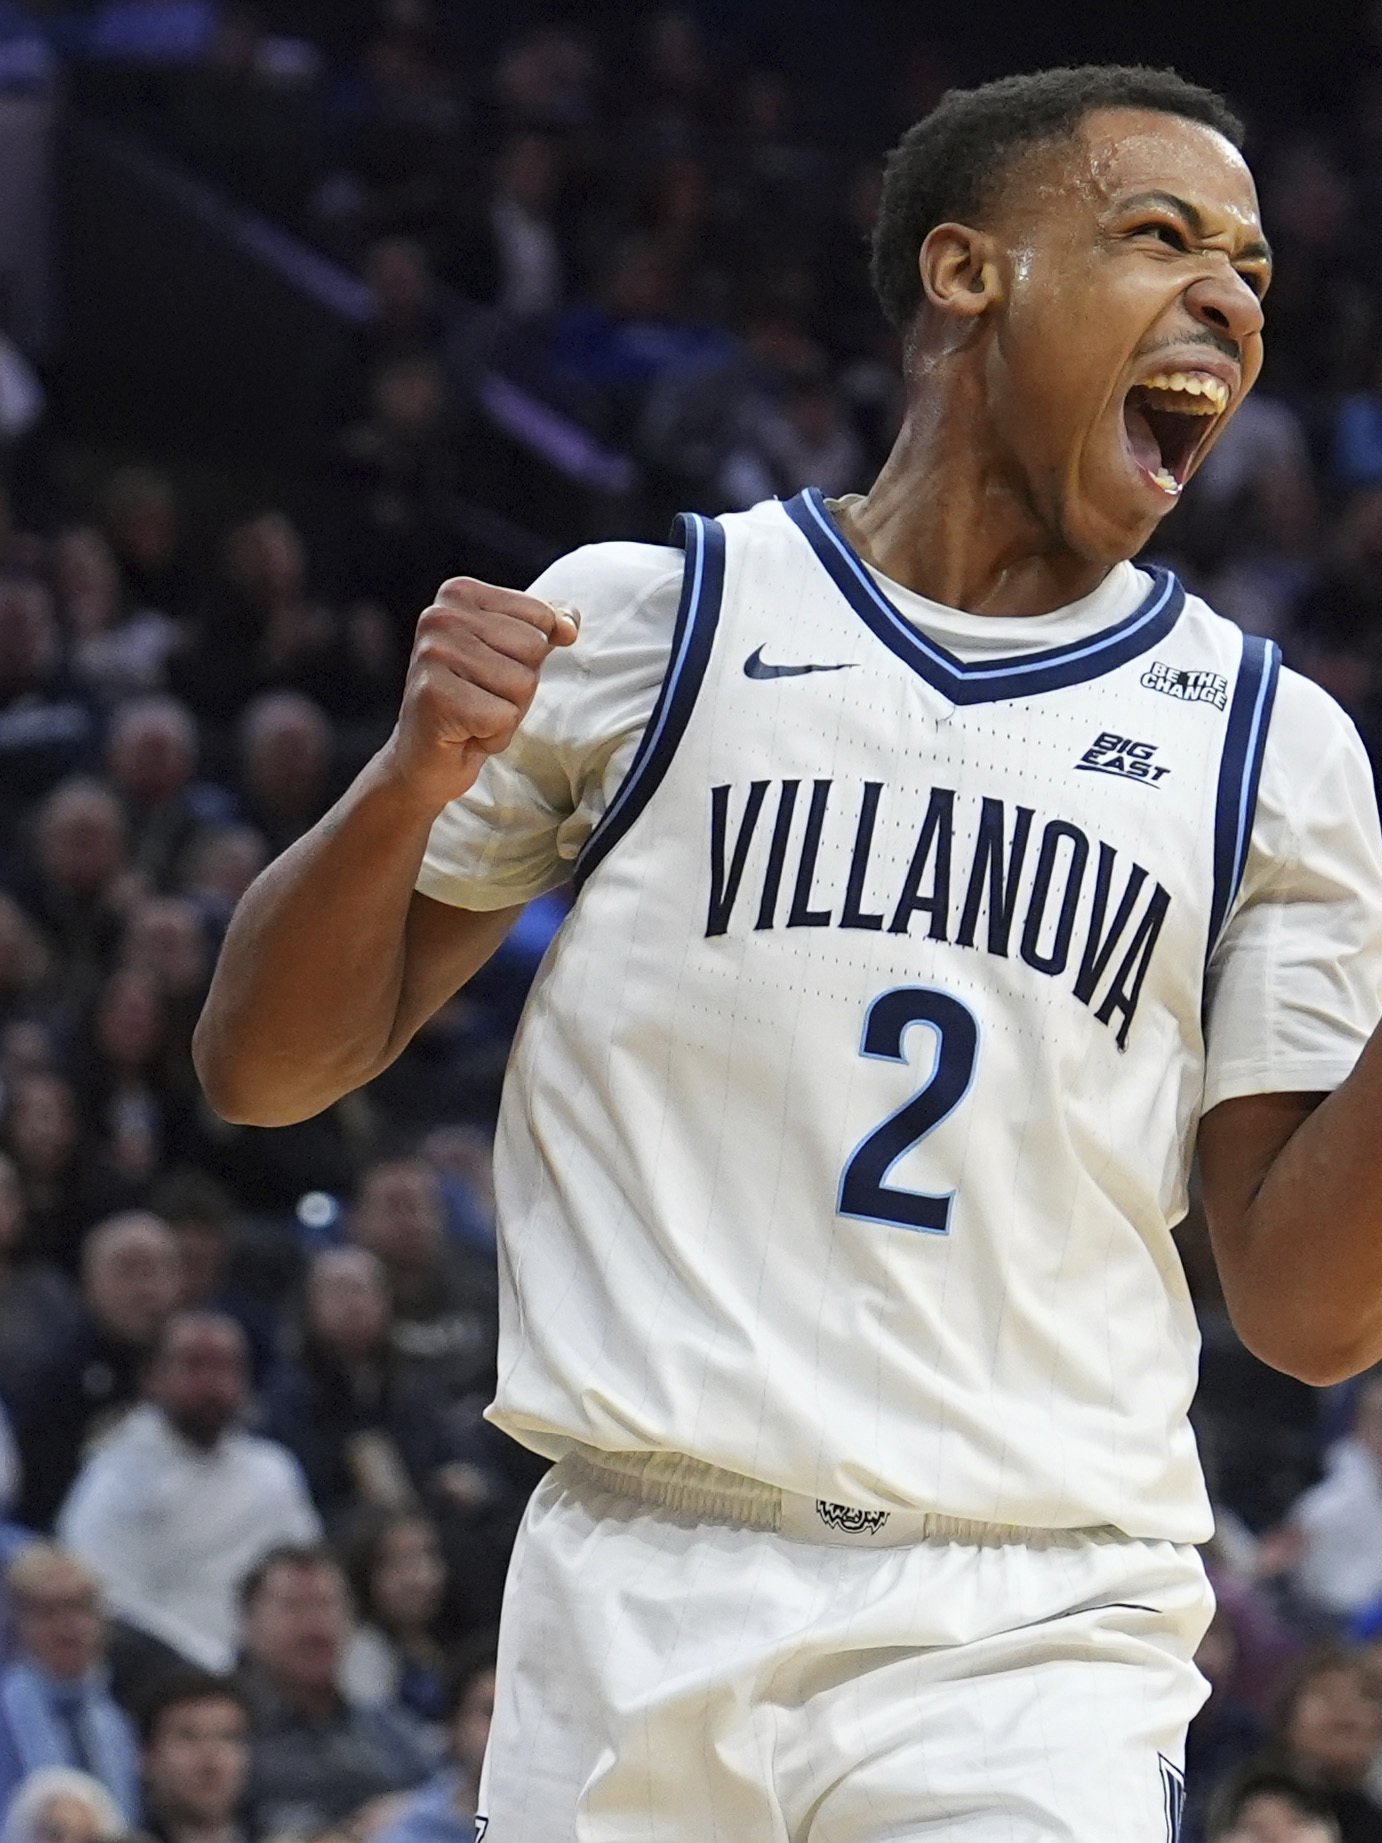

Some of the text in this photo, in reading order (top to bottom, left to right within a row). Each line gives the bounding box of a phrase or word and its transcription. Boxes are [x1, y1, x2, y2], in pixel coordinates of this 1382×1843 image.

[1140, 672, 1228, 712] CHANGE
[1150, 661, 1228, 693] BE THE
[1092, 731, 1160, 760] BIG
[1080, 748, 1172, 781] EAST
[704, 779, 1172, 1051] VILLANOVA
[836, 984, 982, 1236] 2
